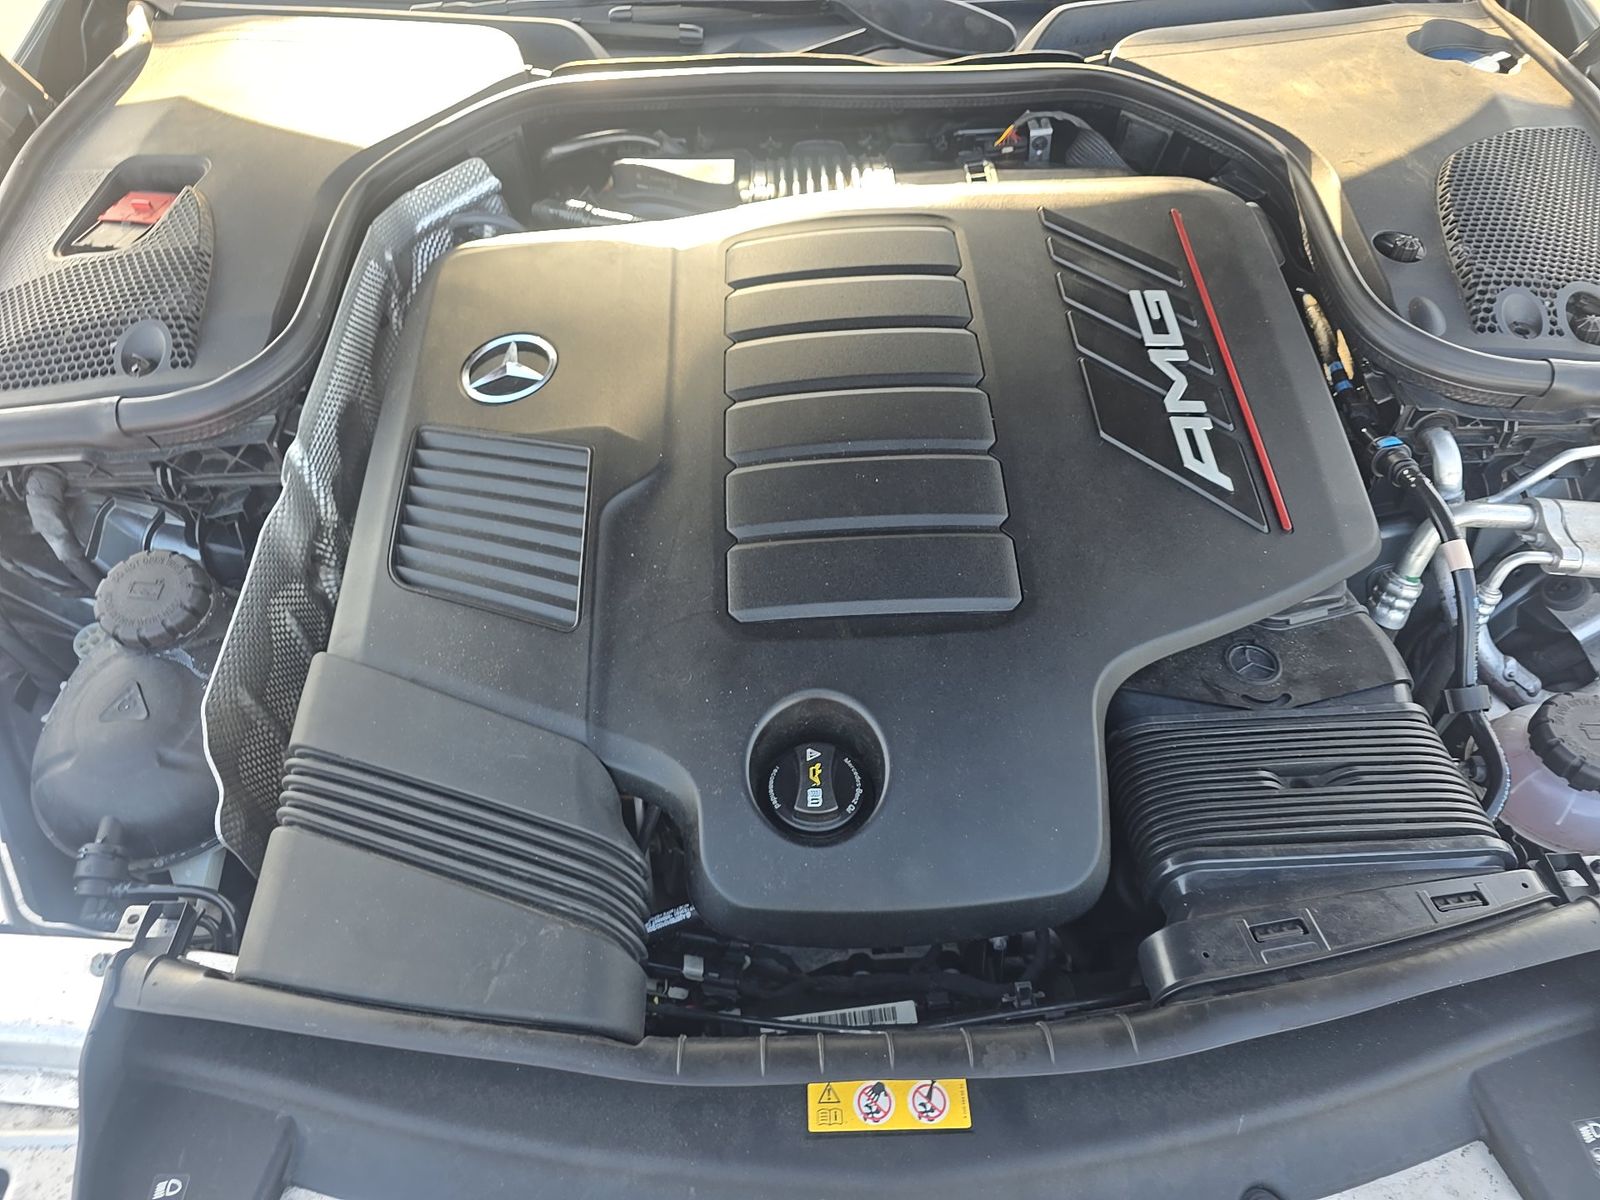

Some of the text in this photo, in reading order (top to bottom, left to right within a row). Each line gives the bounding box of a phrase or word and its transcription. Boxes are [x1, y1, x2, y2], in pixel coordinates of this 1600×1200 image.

[1129, 290, 1235, 492] AMG
[768, 765, 781, 809] recommended
[844, 757, 863, 805] Mercedes-Benz
